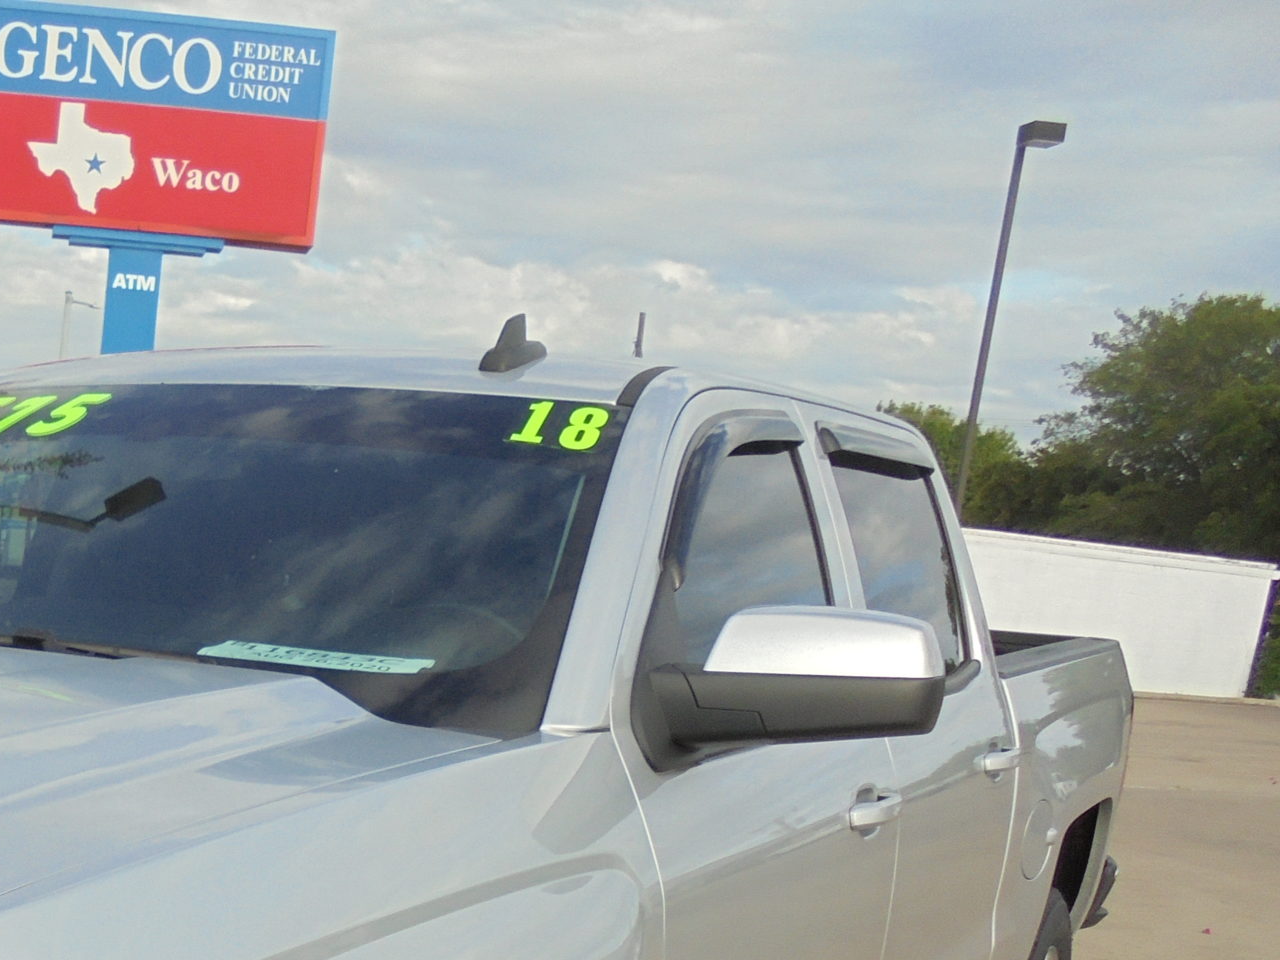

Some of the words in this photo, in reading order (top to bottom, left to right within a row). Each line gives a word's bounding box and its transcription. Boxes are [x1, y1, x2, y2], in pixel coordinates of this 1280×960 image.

[232, 41, 321, 67] FEDERAL
[229, 62, 304, 85] CREDIT
[228, 82, 292, 104] UNION
[151, 157, 240, 193] Waco
[112, 273, 156, 292] ATM
[509, 400, 609, 450] 18
